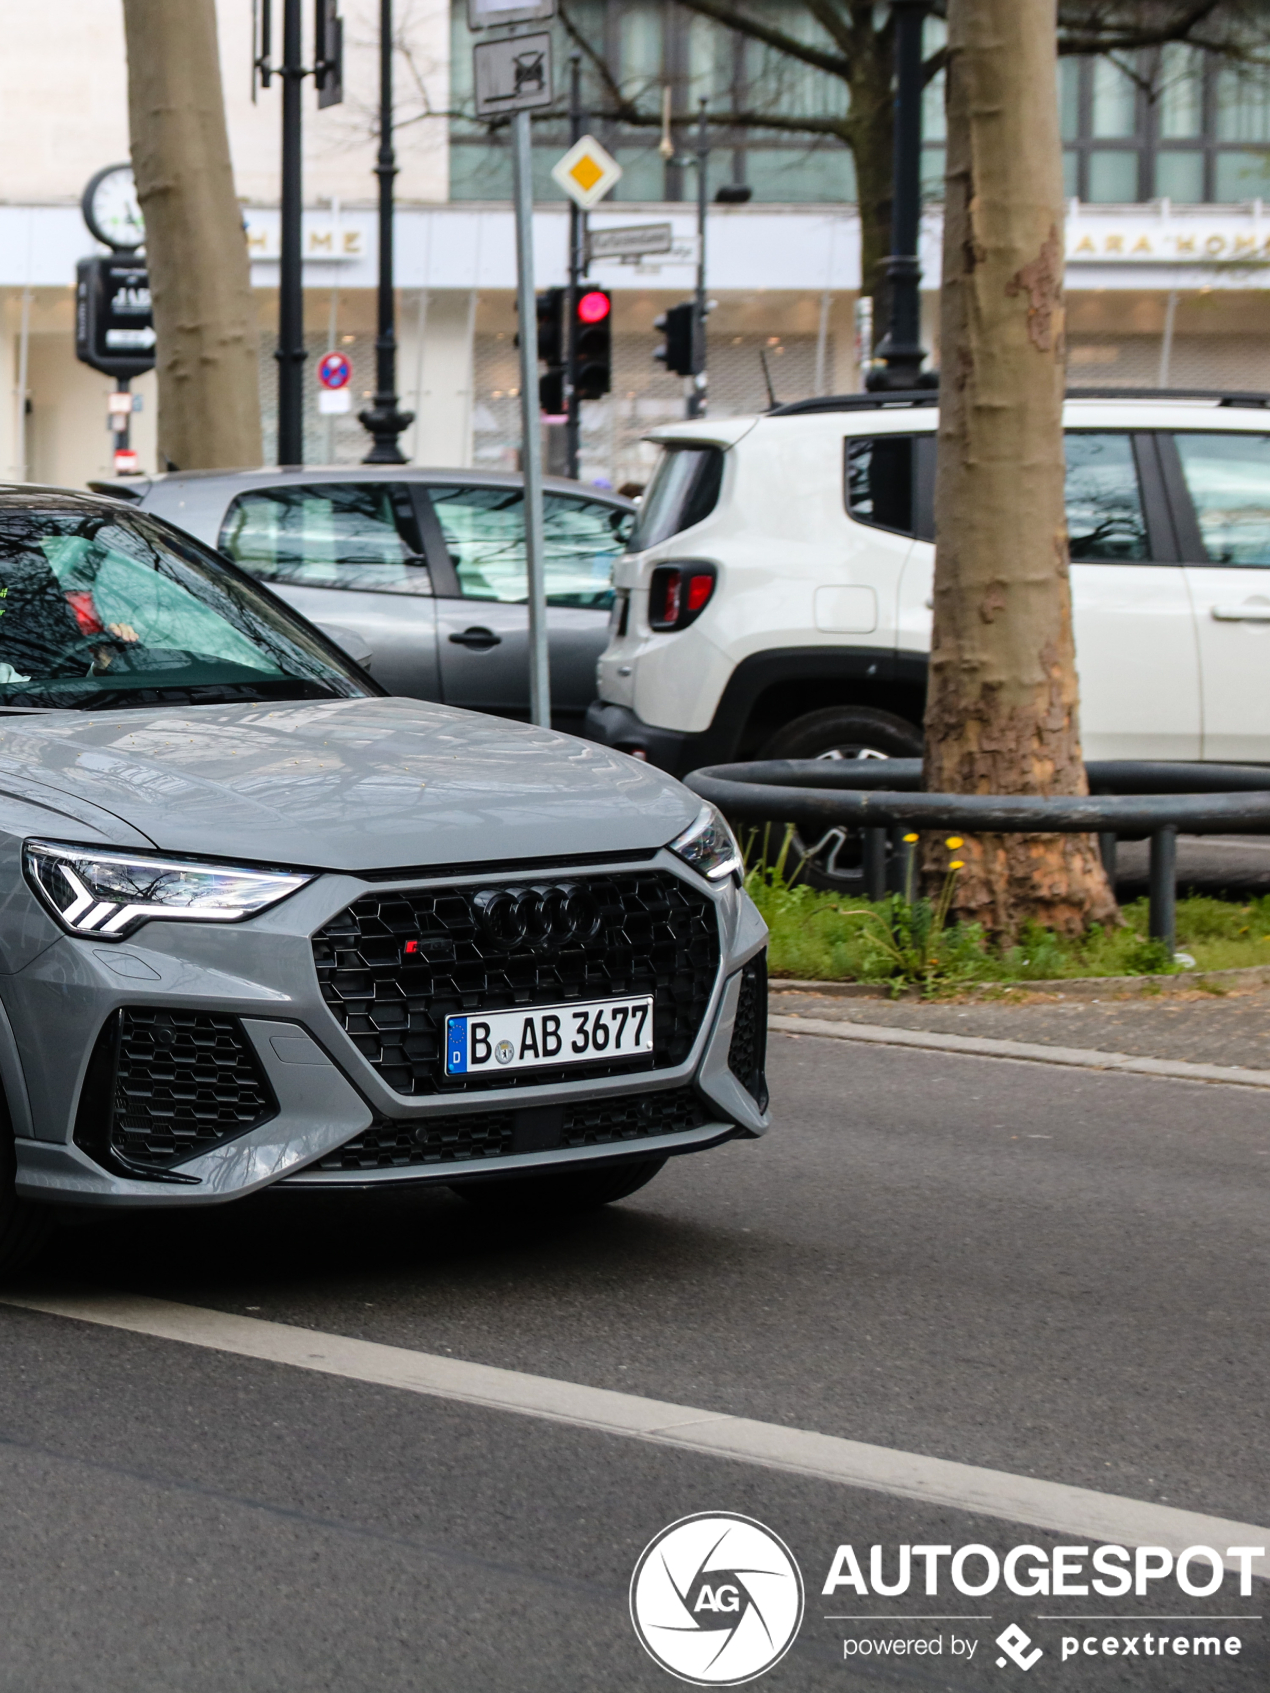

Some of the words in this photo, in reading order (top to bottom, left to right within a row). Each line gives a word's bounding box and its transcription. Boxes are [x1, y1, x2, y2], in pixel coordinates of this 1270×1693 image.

[247, 231, 361, 253] HME
[1075, 235, 1154, 254] ARA
[453, 1051, 461, 1064] D
[470, 1021, 492, 1065] B
[519, 1014, 563, 1060] AB
[571, 1004, 649, 1054] 3677
